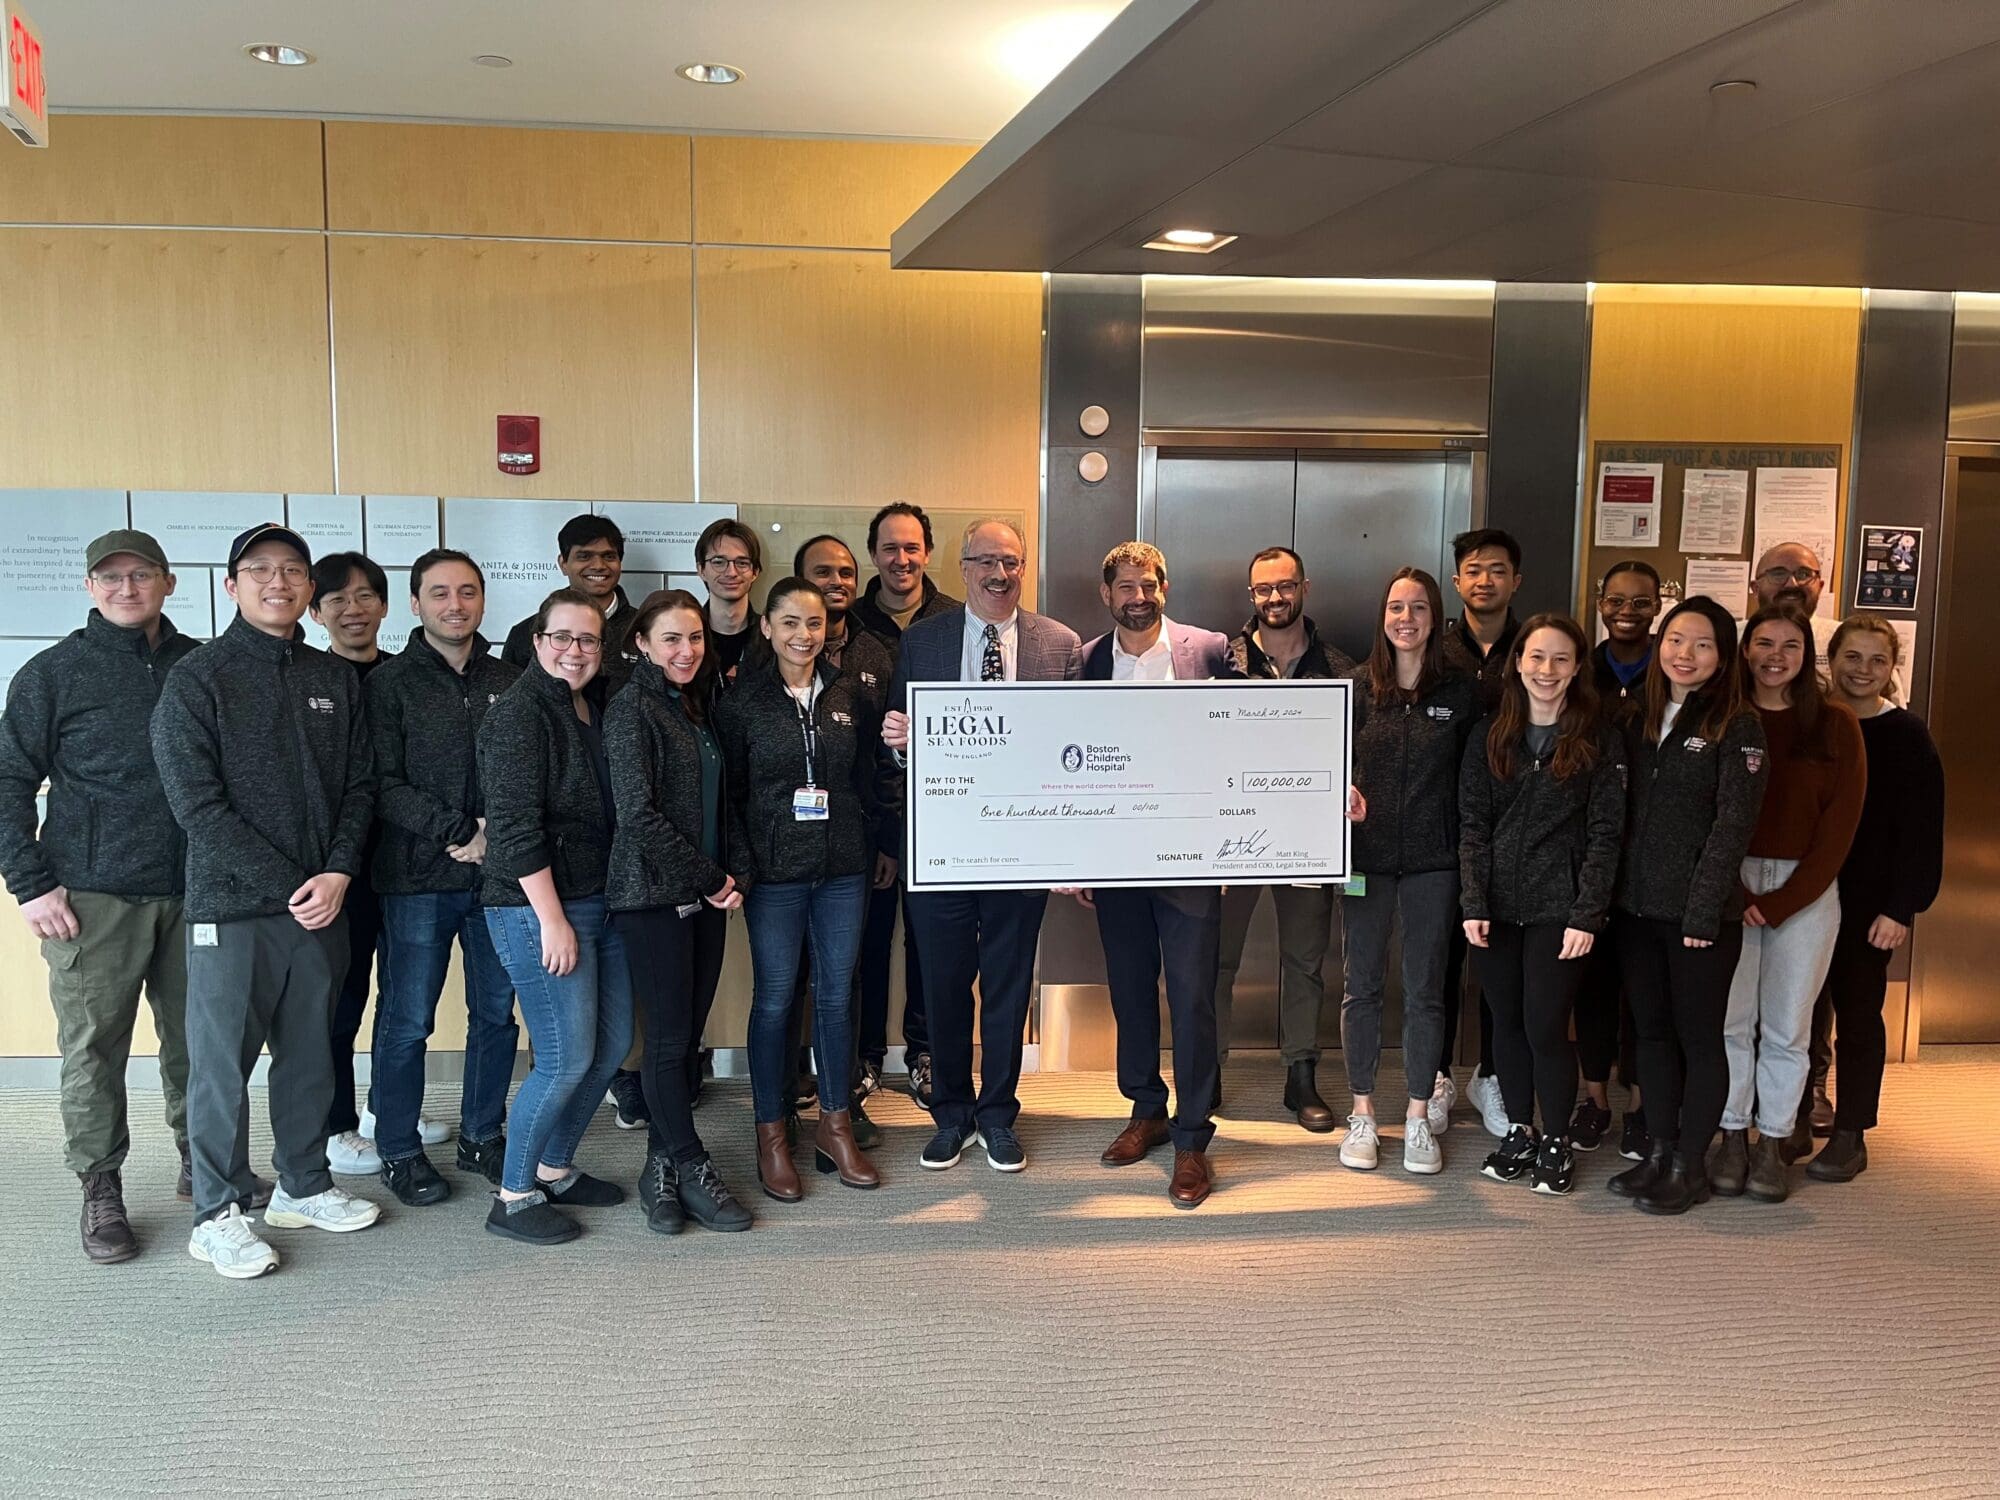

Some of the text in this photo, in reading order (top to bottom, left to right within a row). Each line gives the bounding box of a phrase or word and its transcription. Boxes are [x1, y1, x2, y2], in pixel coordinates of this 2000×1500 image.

[12, 15, 42, 121] EXIT
[1727, 449, 1786, 467] SAFETY
[1791, 450, 1836, 467] NEWS
[37, 535, 79, 543] recognition
[2, 546, 10, 554] of
[12, 546, 60, 556] extraordinary
[33, 559, 63, 569] inspired
[522, 562, 559, 571] JOSHUA
[490, 572, 548, 580] BEKENSTEIN
[17, 584, 47, 592] research
[61, 584, 74, 592] this
[1209, 711, 1231, 719] DATE
[1238, 707, 1268, 717] March
[925, 715, 1012, 735] LEGAL
[927, 736, 1007, 746] SEA FOODS
[1086, 745, 1120, 753] Boston
[961, 751, 993, 760] ENGLAND
[1086, 753, 1132, 762] Children's
[1086, 762, 1125, 773] Hospital
[944, 776, 956, 784] TO
[958, 776, 975, 784] THE
[1227, 777, 1312, 791] $ 100,000.00
[925, 788, 969, 796] ORDER OF
[980, 802, 1159, 818] One hundred thousand 00/100
[1219, 808, 1257, 816] DOLLARS
[1156, 853, 1204, 861] SIGNATURE
[1293, 850, 1309, 859] King
[929, 858, 946, 866] FOR
[1245, 861, 1257, 869] and
[1276, 861, 1294, 870] Legal
[1308, 860, 1327, 868] Foods
